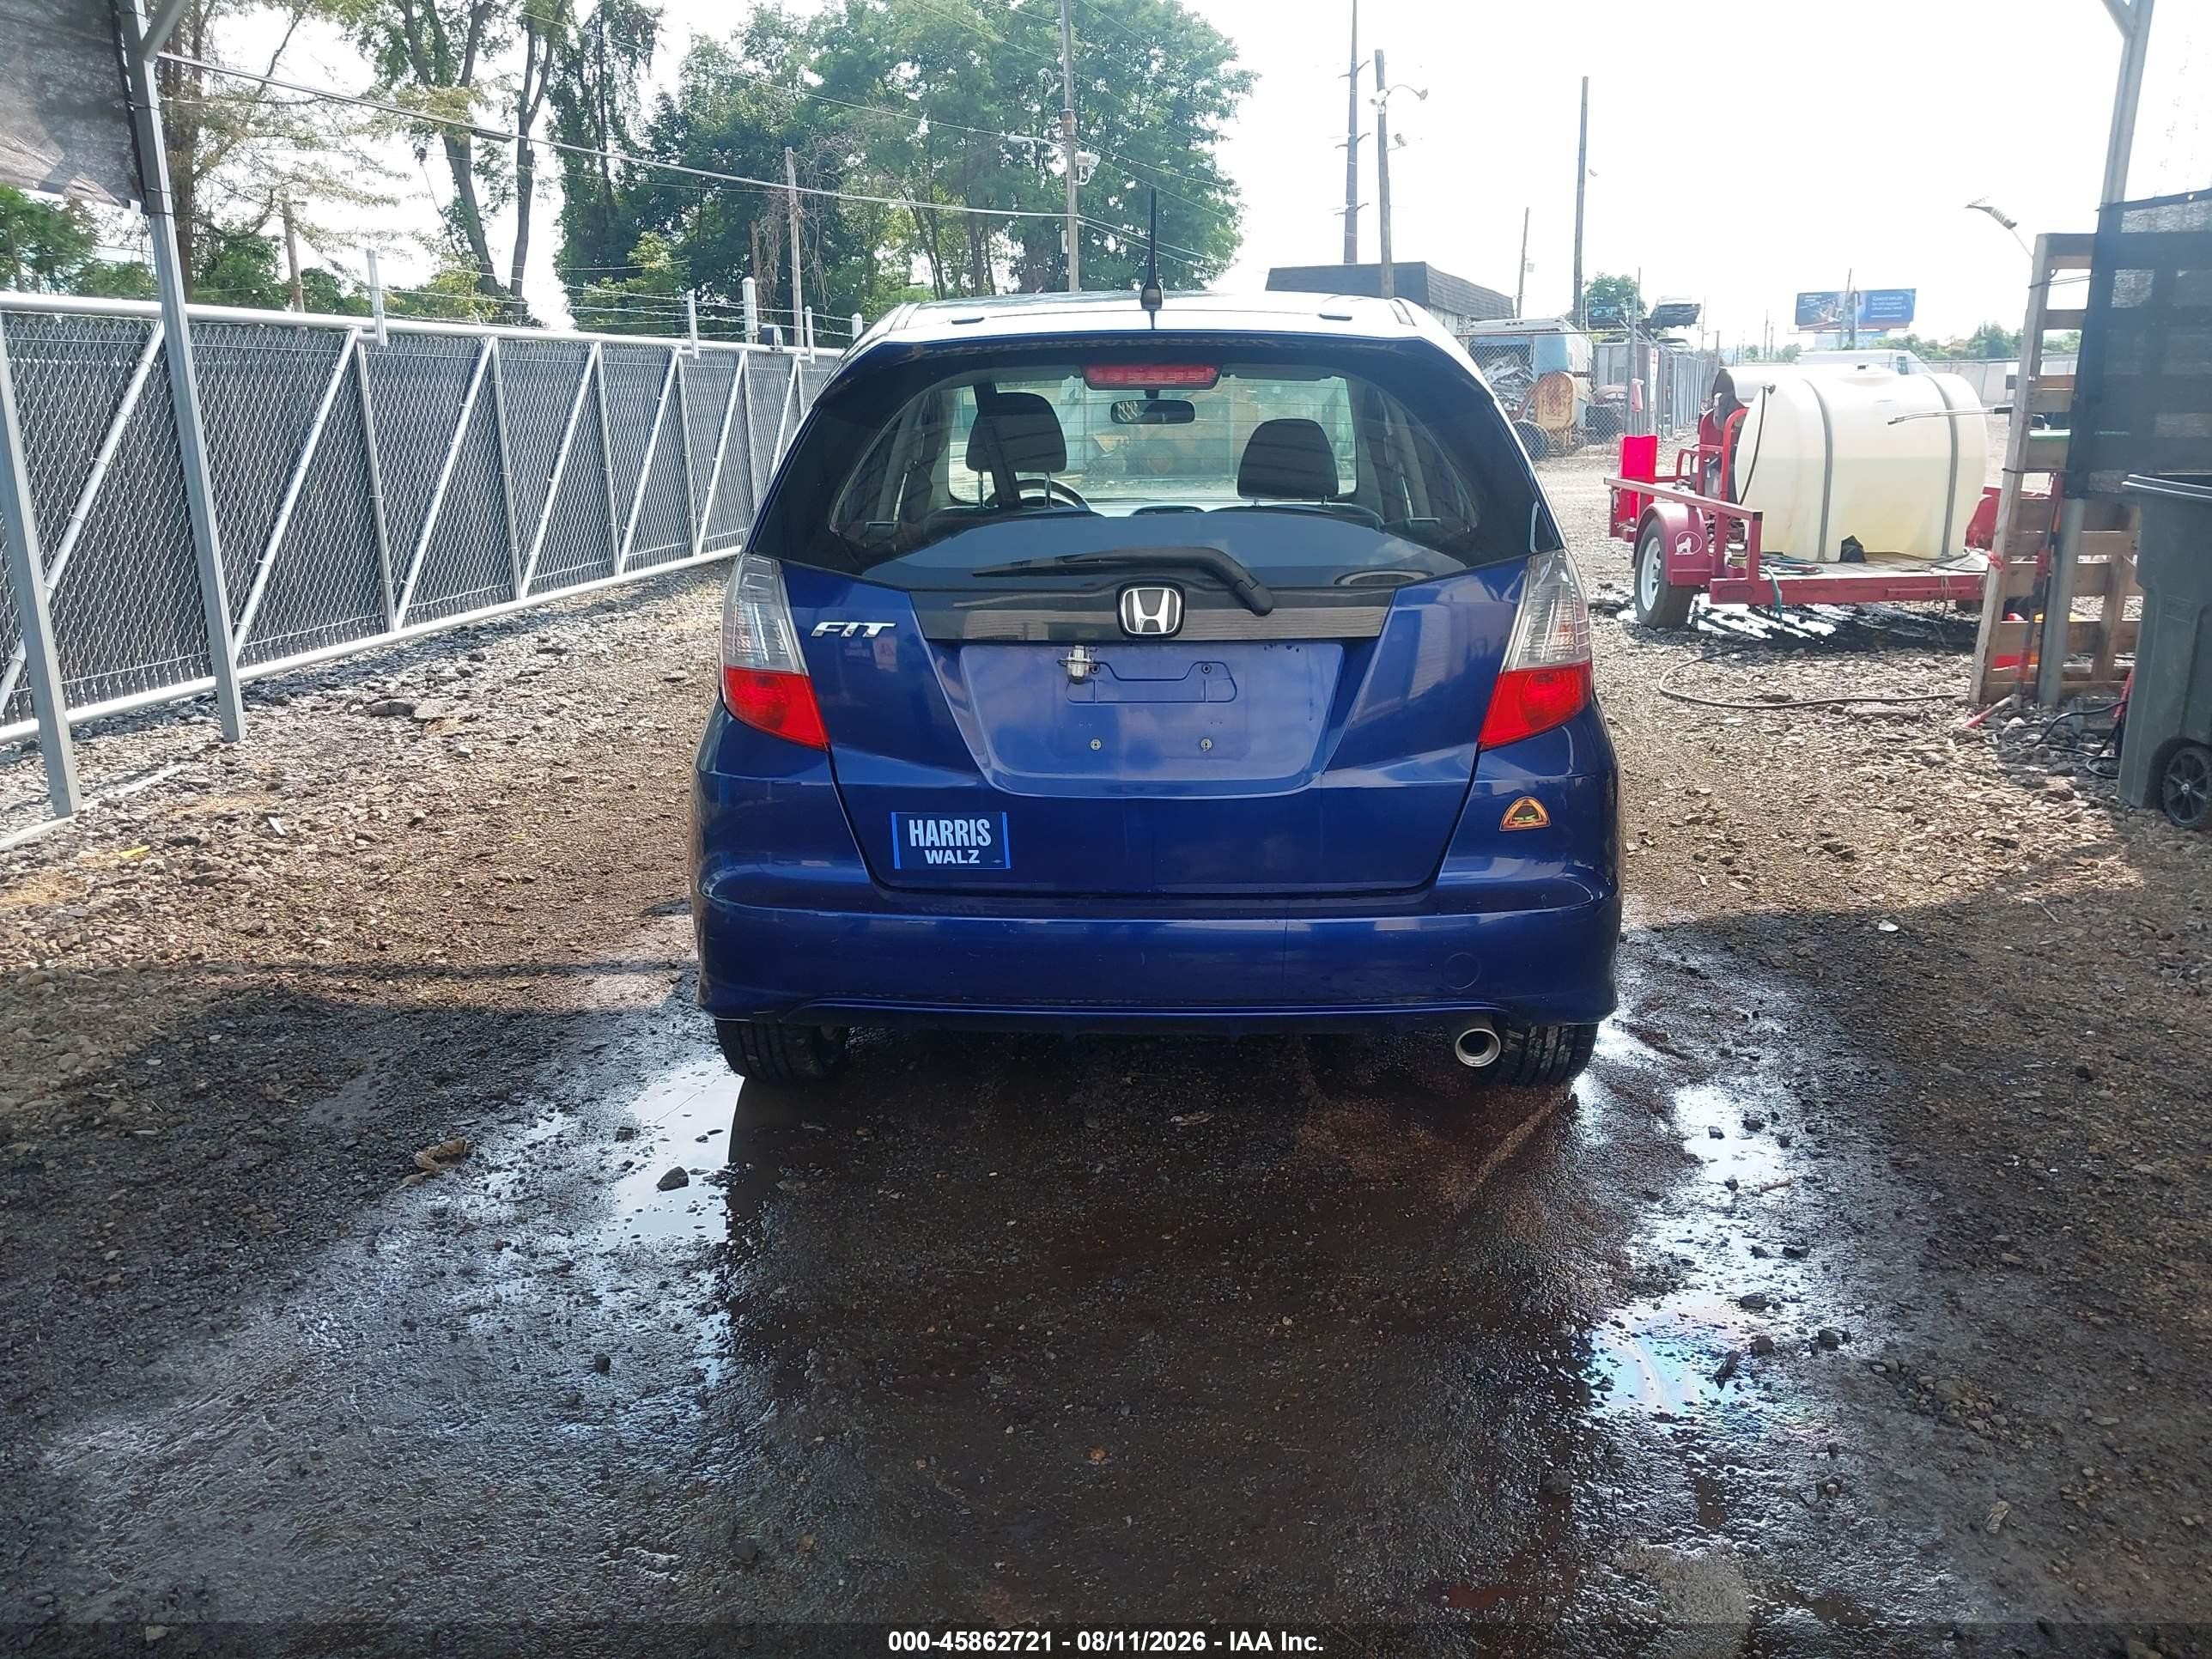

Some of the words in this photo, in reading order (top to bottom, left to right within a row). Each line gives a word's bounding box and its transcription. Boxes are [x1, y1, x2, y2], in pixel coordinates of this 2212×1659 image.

[811, 622, 896, 637] FIT
[908, 818, 992, 847] HARRIS
[924, 849, 981, 865] WALZ
